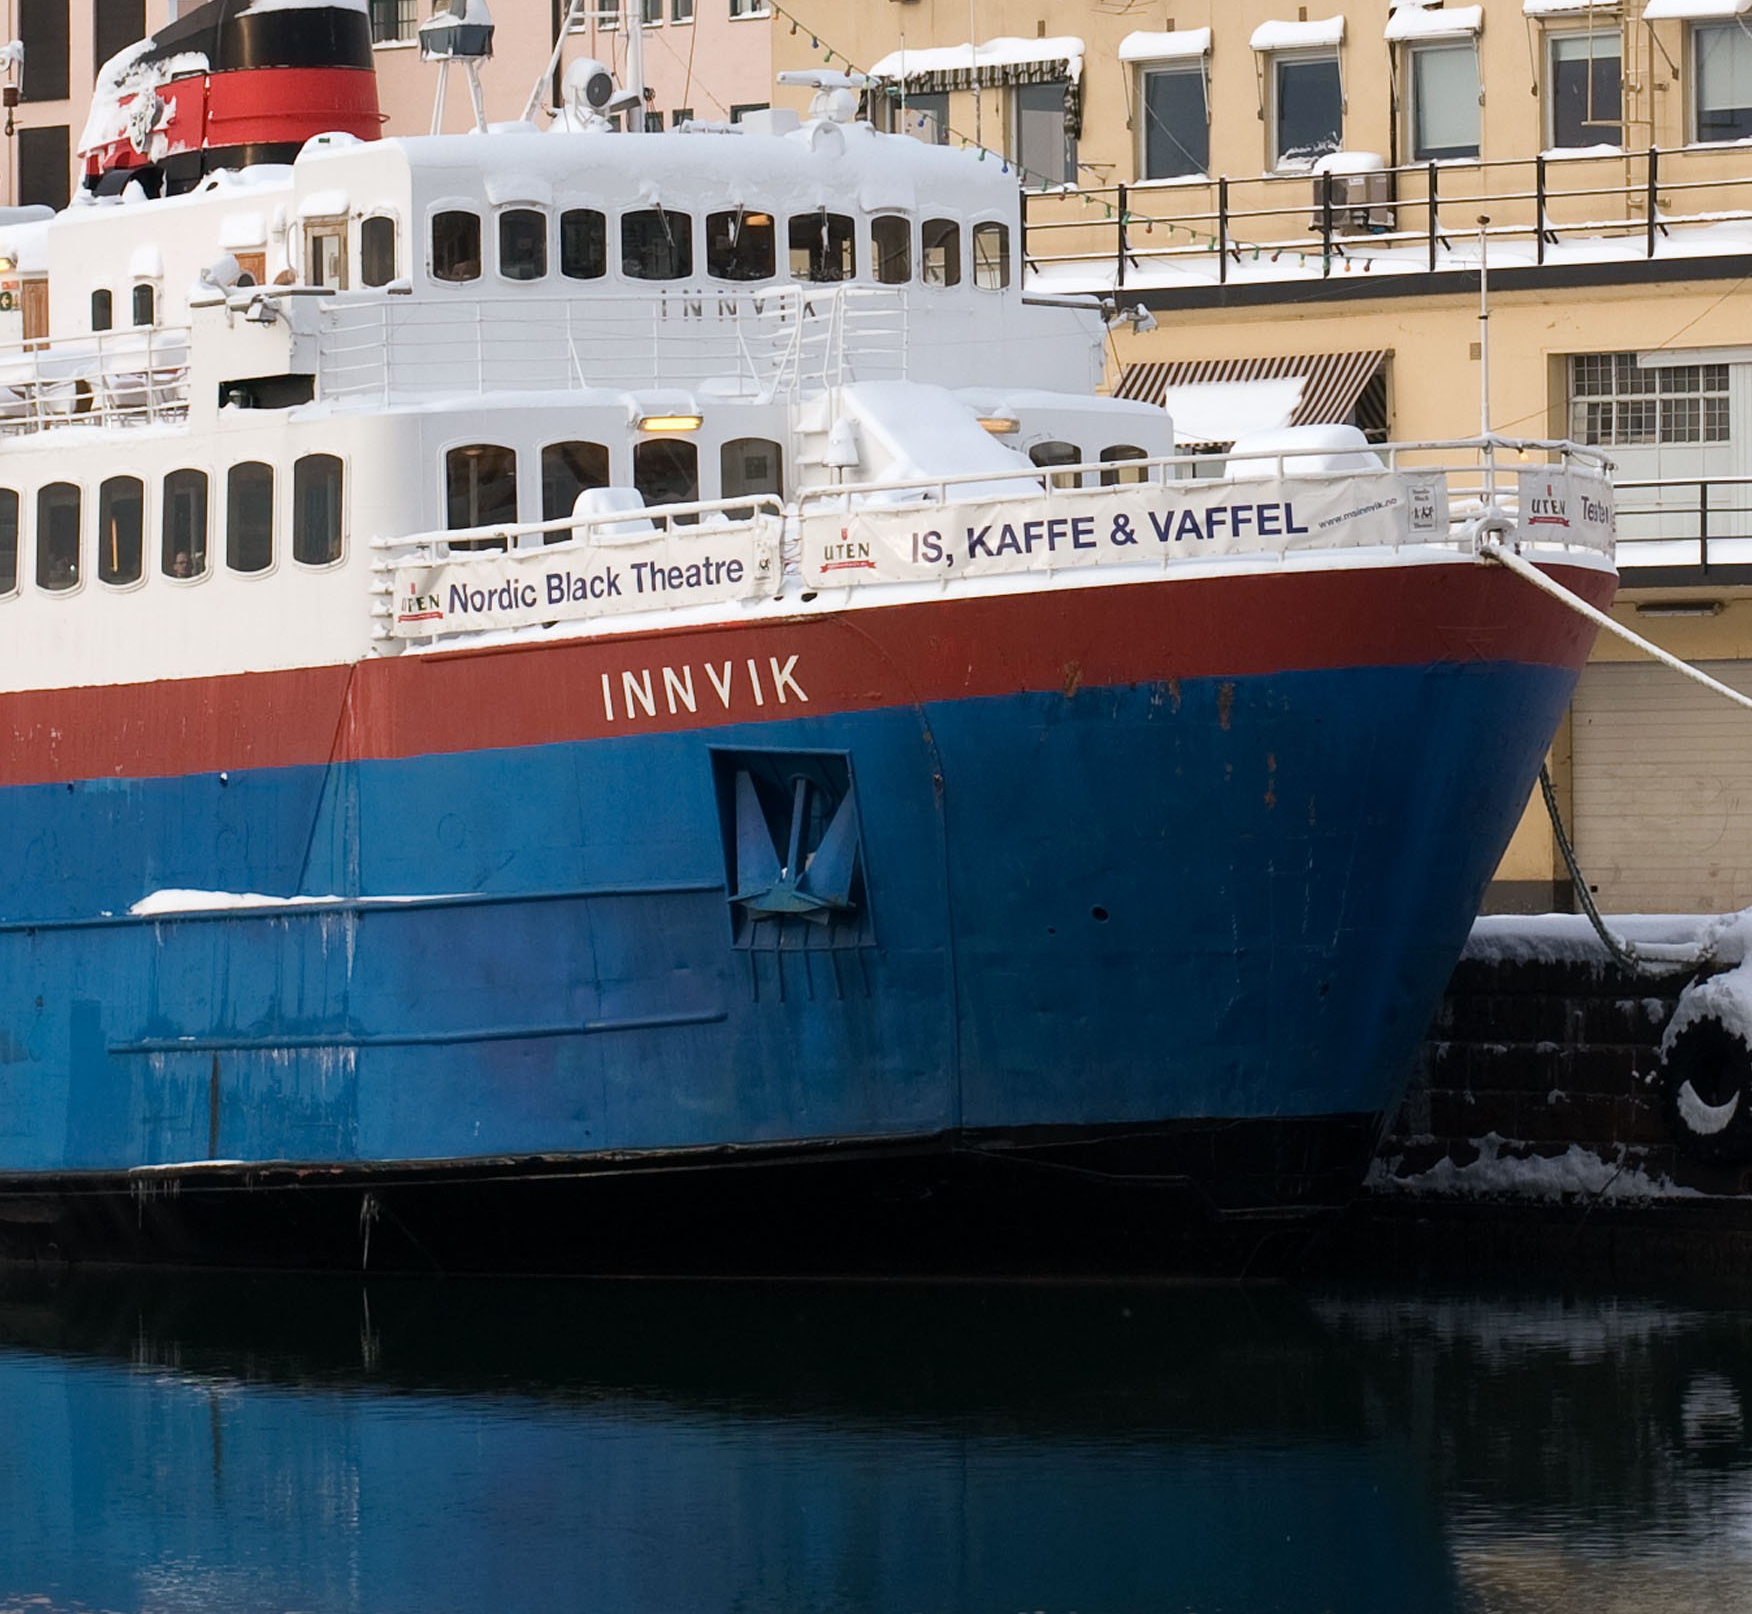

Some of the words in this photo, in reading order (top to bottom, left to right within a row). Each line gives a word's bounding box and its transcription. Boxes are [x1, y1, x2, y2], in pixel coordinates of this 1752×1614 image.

[912, 530, 954, 567] IS,
[967, 516, 1097, 559] KAFFE
[1110, 513, 1138, 546] &
[1148, 502, 1309, 542] VAFFEL
[1532, 498, 1565, 515] UTEN
[824, 543, 870, 560] UTEN
[448, 579, 537, 614] Nordic
[546, 567, 622, 605] Black
[630, 556, 744, 594] Theatre
[601, 654, 809, 721] INNVIK
